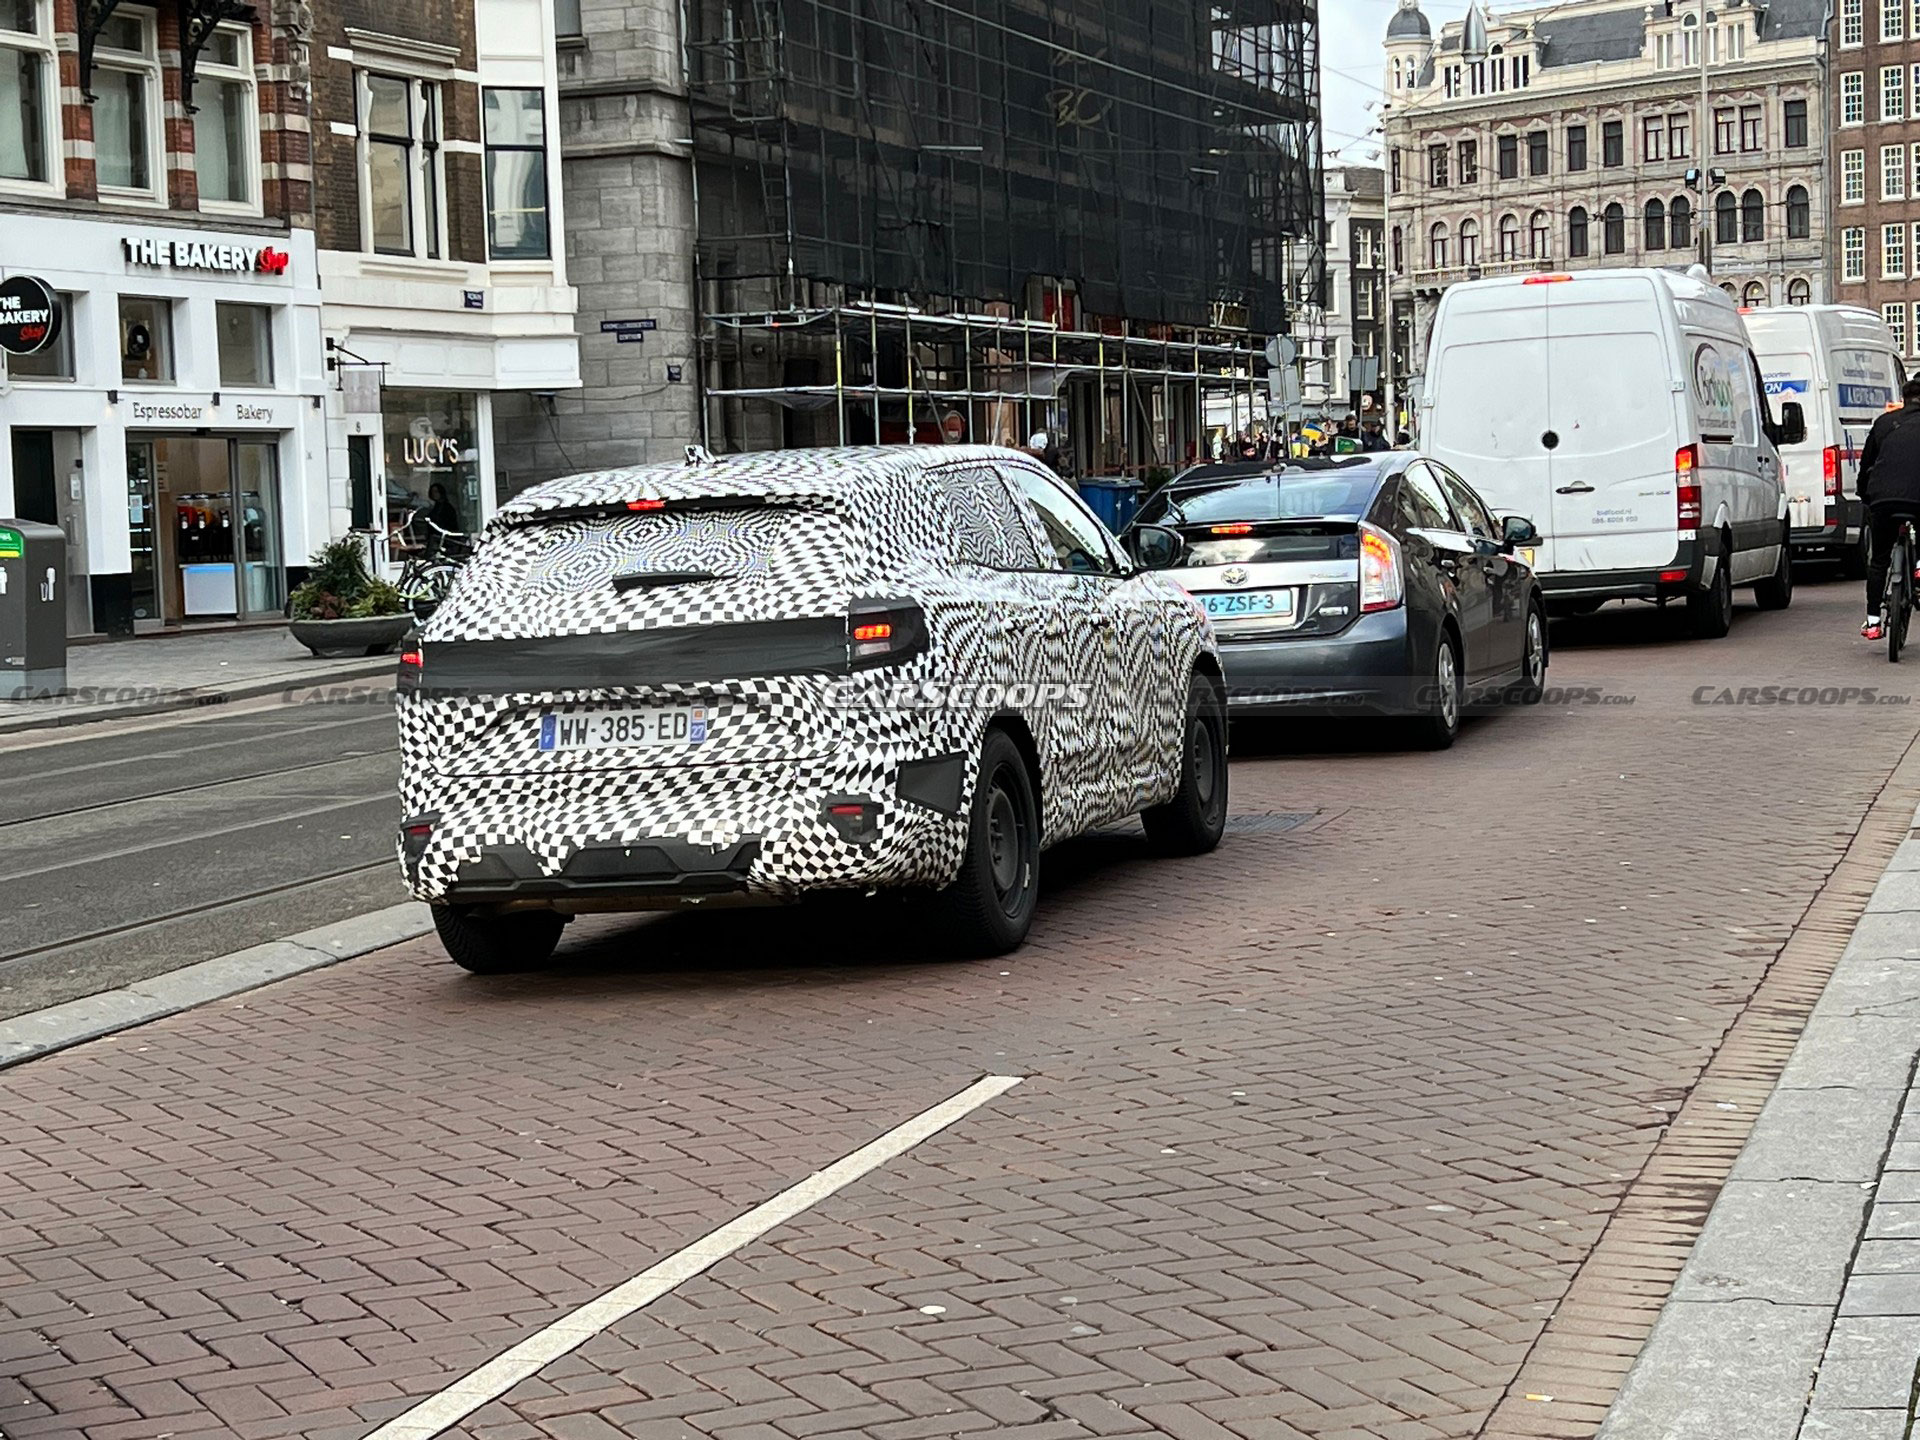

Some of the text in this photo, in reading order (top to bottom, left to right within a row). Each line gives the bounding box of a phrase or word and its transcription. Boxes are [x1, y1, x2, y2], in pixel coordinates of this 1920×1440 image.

[125, 237, 171, 265] THE
[174, 241, 257, 271] BAKERY
[132, 402, 274, 423] Espressobar Bakery
[403, 437, 460, 464] LUCY'S
[560, 712, 687, 746] WW-385-ED
[692, 725, 704, 738] 27
